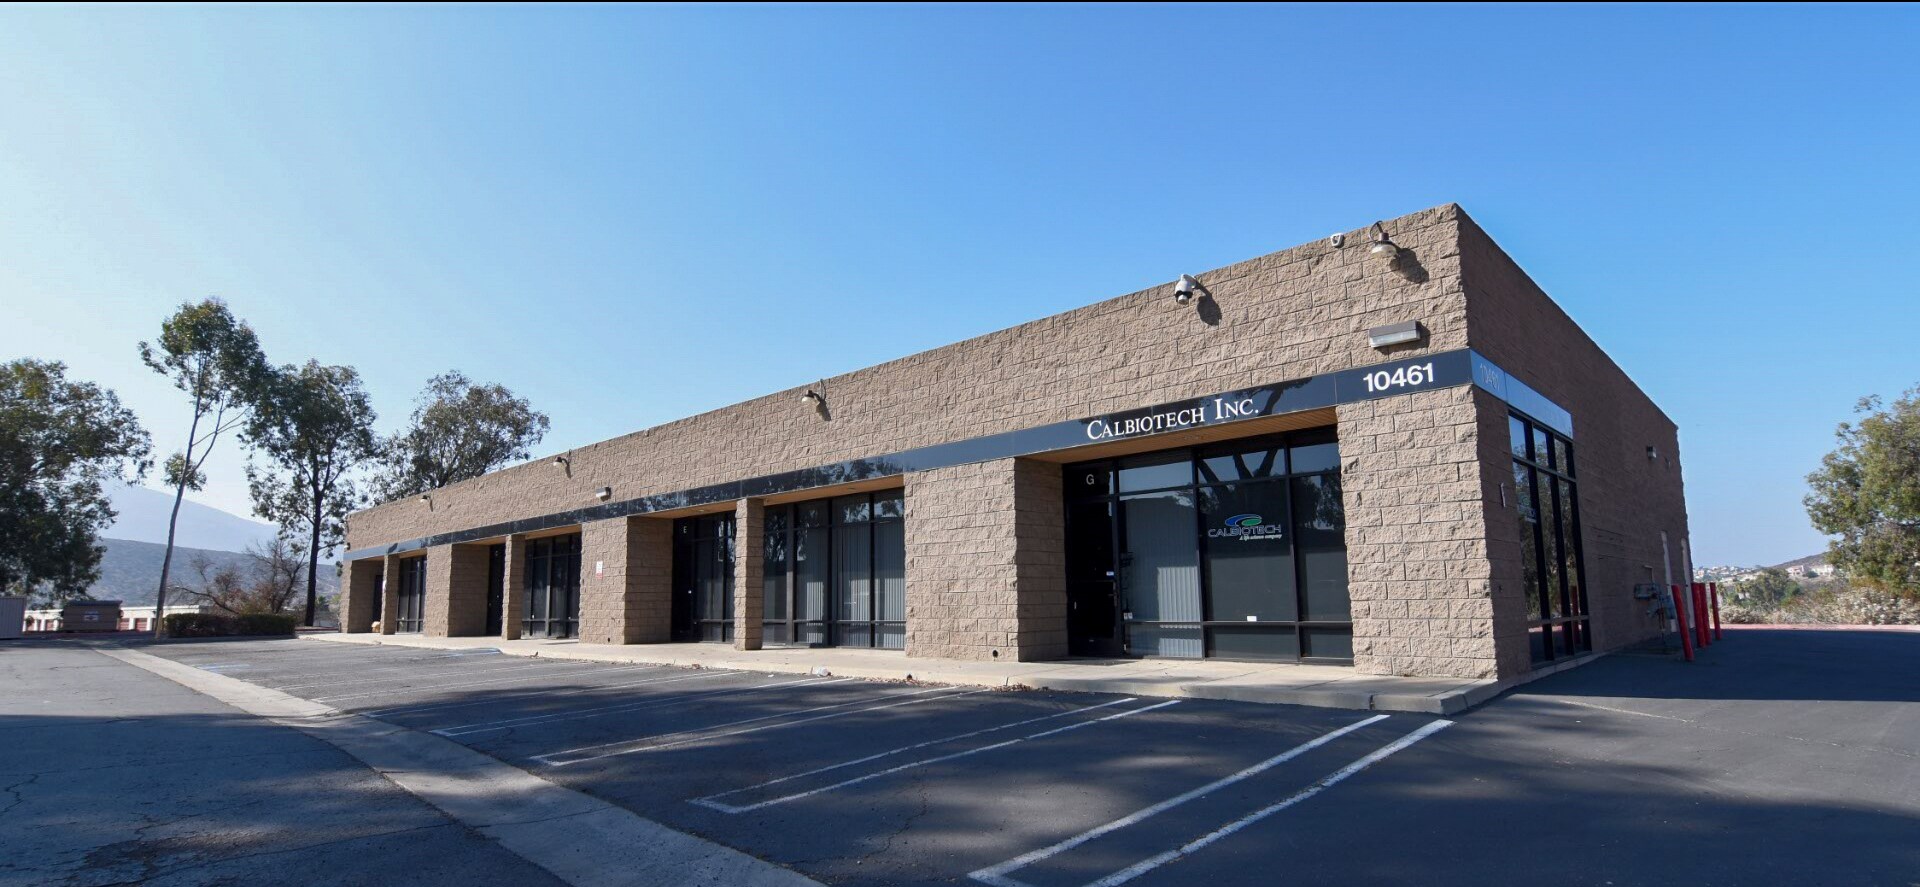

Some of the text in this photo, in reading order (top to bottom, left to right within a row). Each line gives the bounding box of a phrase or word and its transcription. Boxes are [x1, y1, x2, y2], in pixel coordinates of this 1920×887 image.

[1362, 362, 1434, 392] 10461
[1087, 398, 1259, 440] CALBIOTECH INC.
[1086, 473, 1095, 485] G
[1208, 524, 1282, 538] CALBIOTECH
